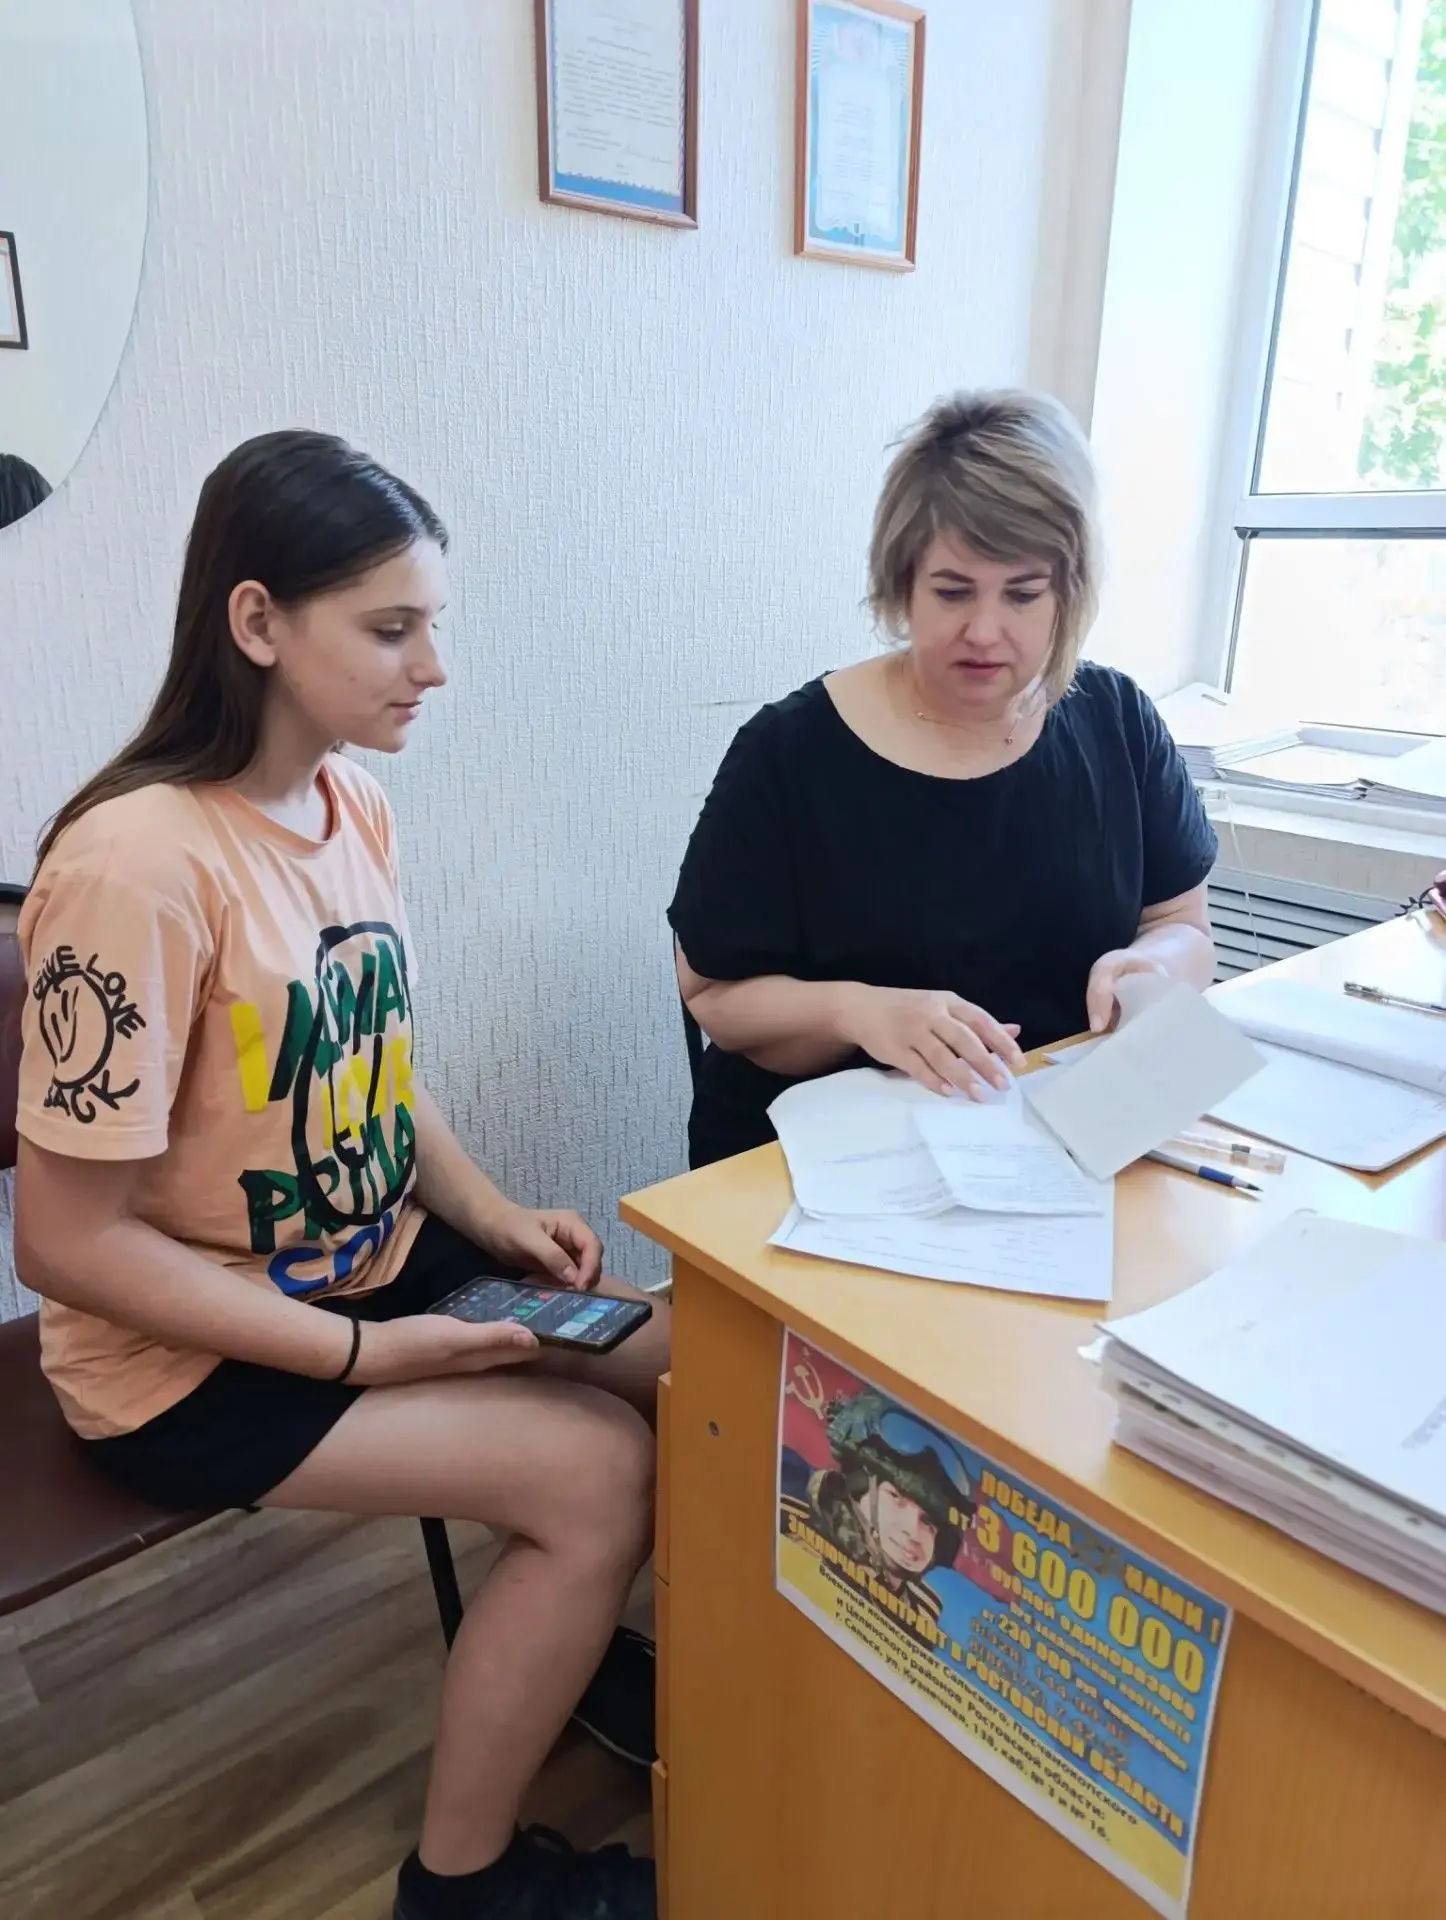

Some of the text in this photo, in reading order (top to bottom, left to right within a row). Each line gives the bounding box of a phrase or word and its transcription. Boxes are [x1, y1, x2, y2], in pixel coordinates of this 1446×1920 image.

[86, 953, 147, 1040] LOVE
[976, 1504, 1000, 1554] 3
[1012, 1528, 1096, 1621] 600
[1109, 1593, 1204, 1694] 000
[981, 1471, 1070, 1549] ПОБЕДА
[1124, 1564, 1203, 1630] НАМИ
